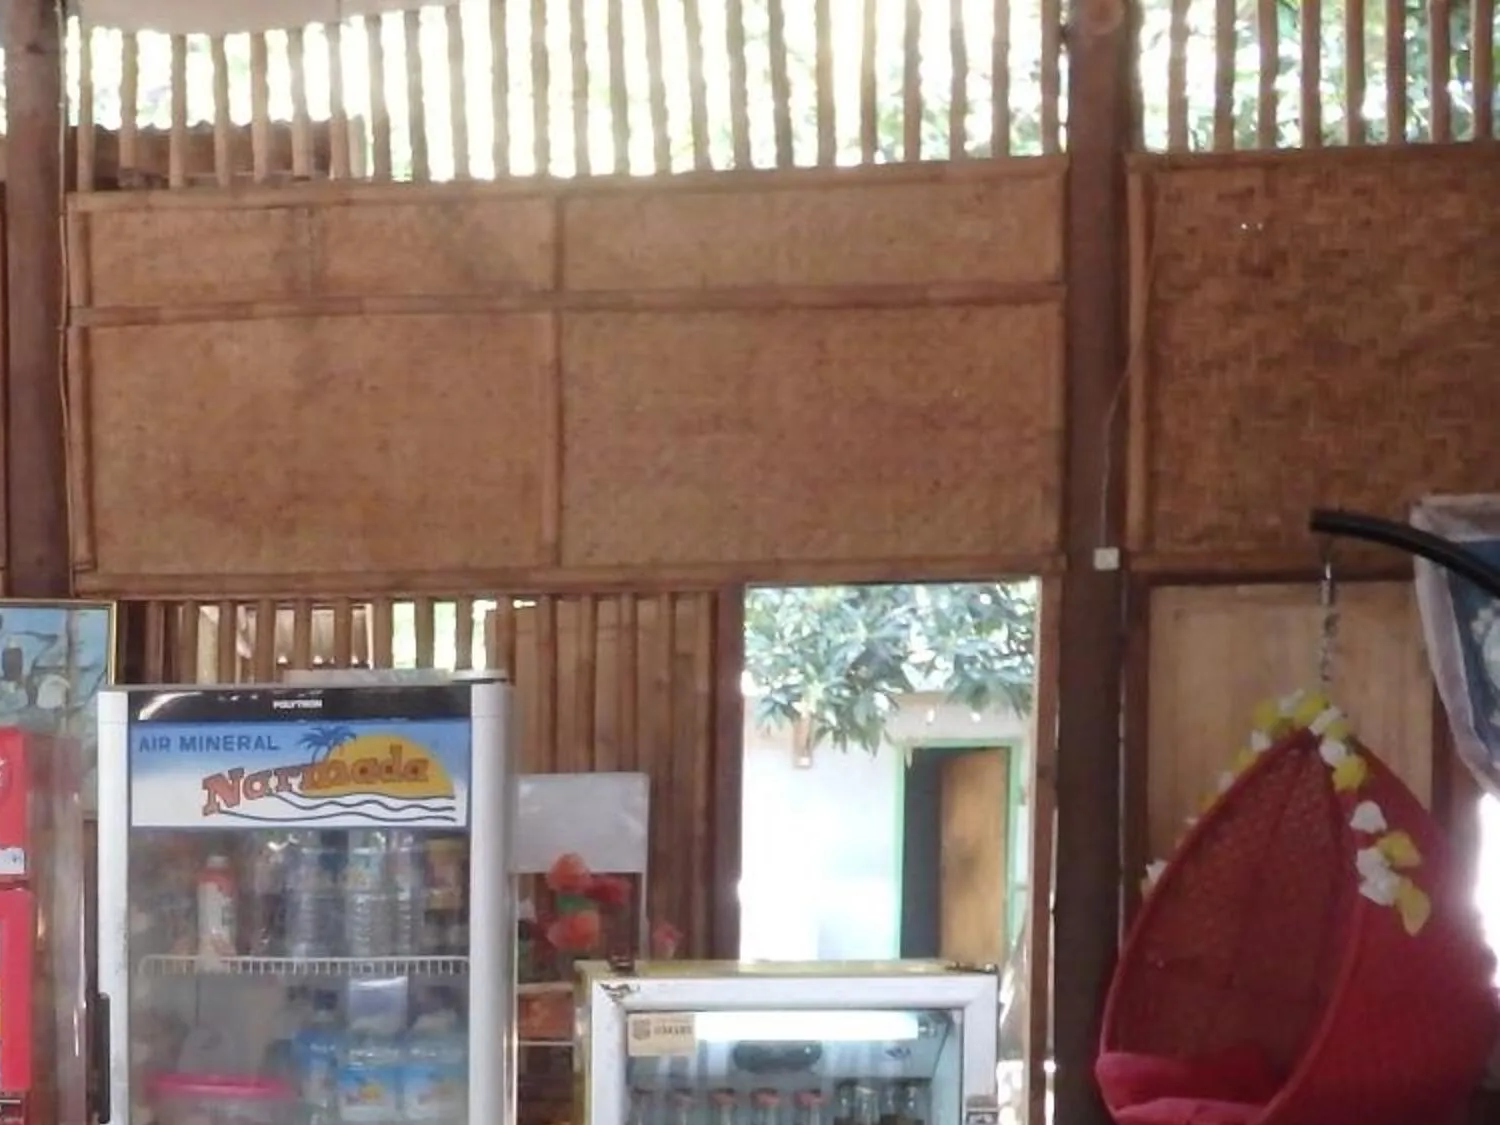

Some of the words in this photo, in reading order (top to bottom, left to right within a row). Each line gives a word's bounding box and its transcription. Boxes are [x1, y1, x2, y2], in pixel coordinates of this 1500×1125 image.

[139, 736, 171, 752] AIR
[179, 735, 281, 752] MINERAL
[202, 743, 429, 816] Narmada
